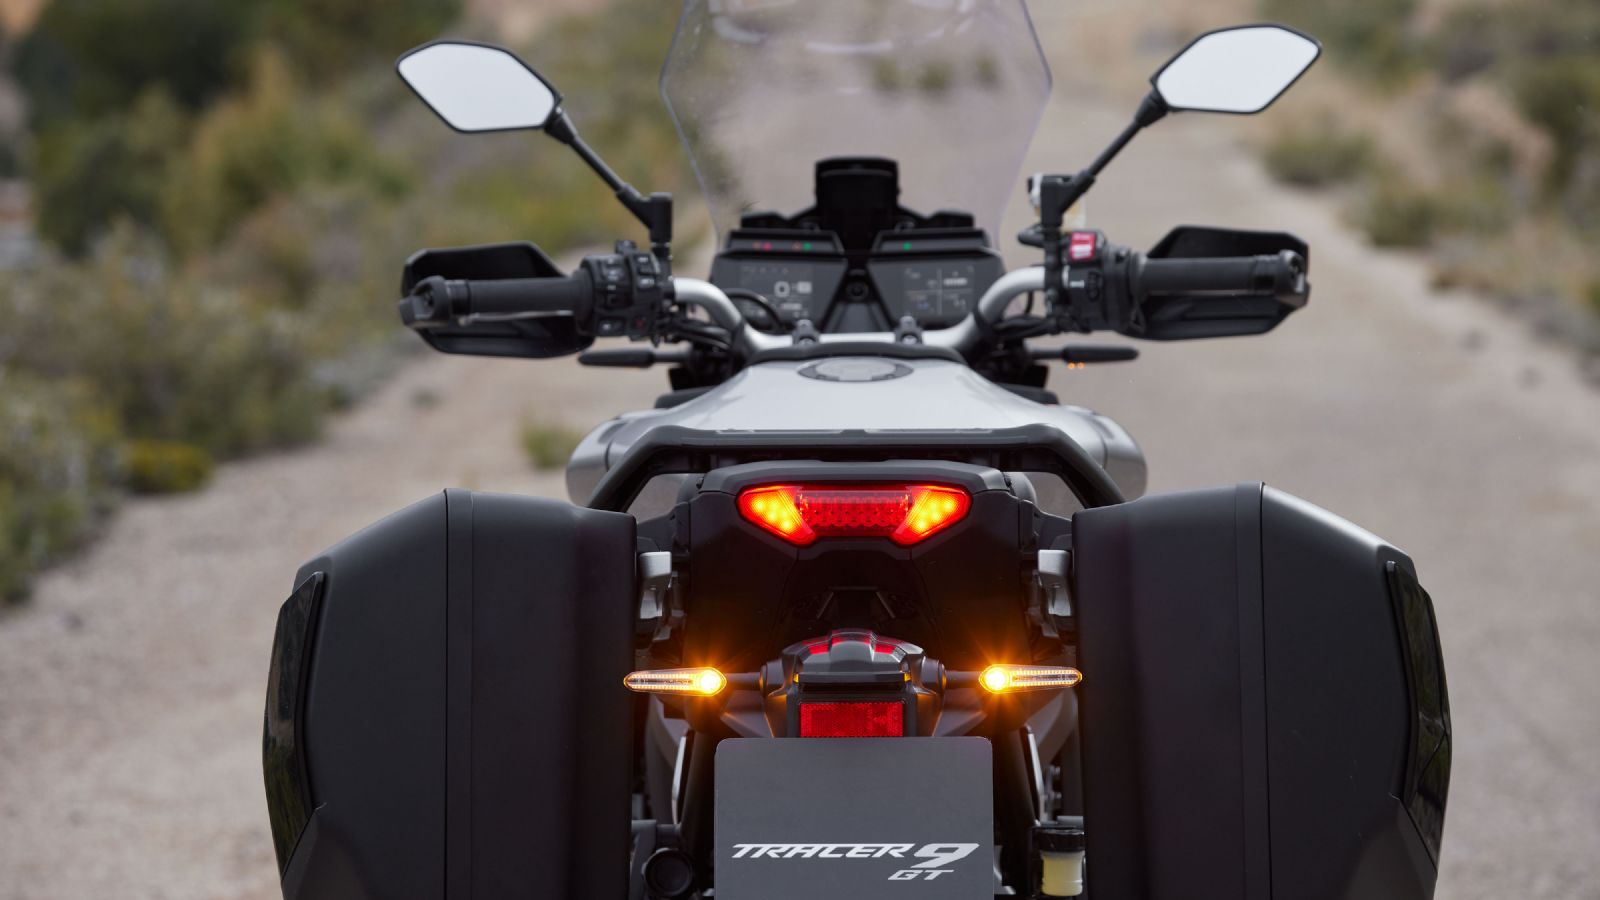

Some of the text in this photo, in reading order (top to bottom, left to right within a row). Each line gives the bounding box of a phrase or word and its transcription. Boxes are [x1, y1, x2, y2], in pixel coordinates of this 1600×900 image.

[731, 843, 980, 869] TRACER 9
[887, 869, 955, 881] GT
